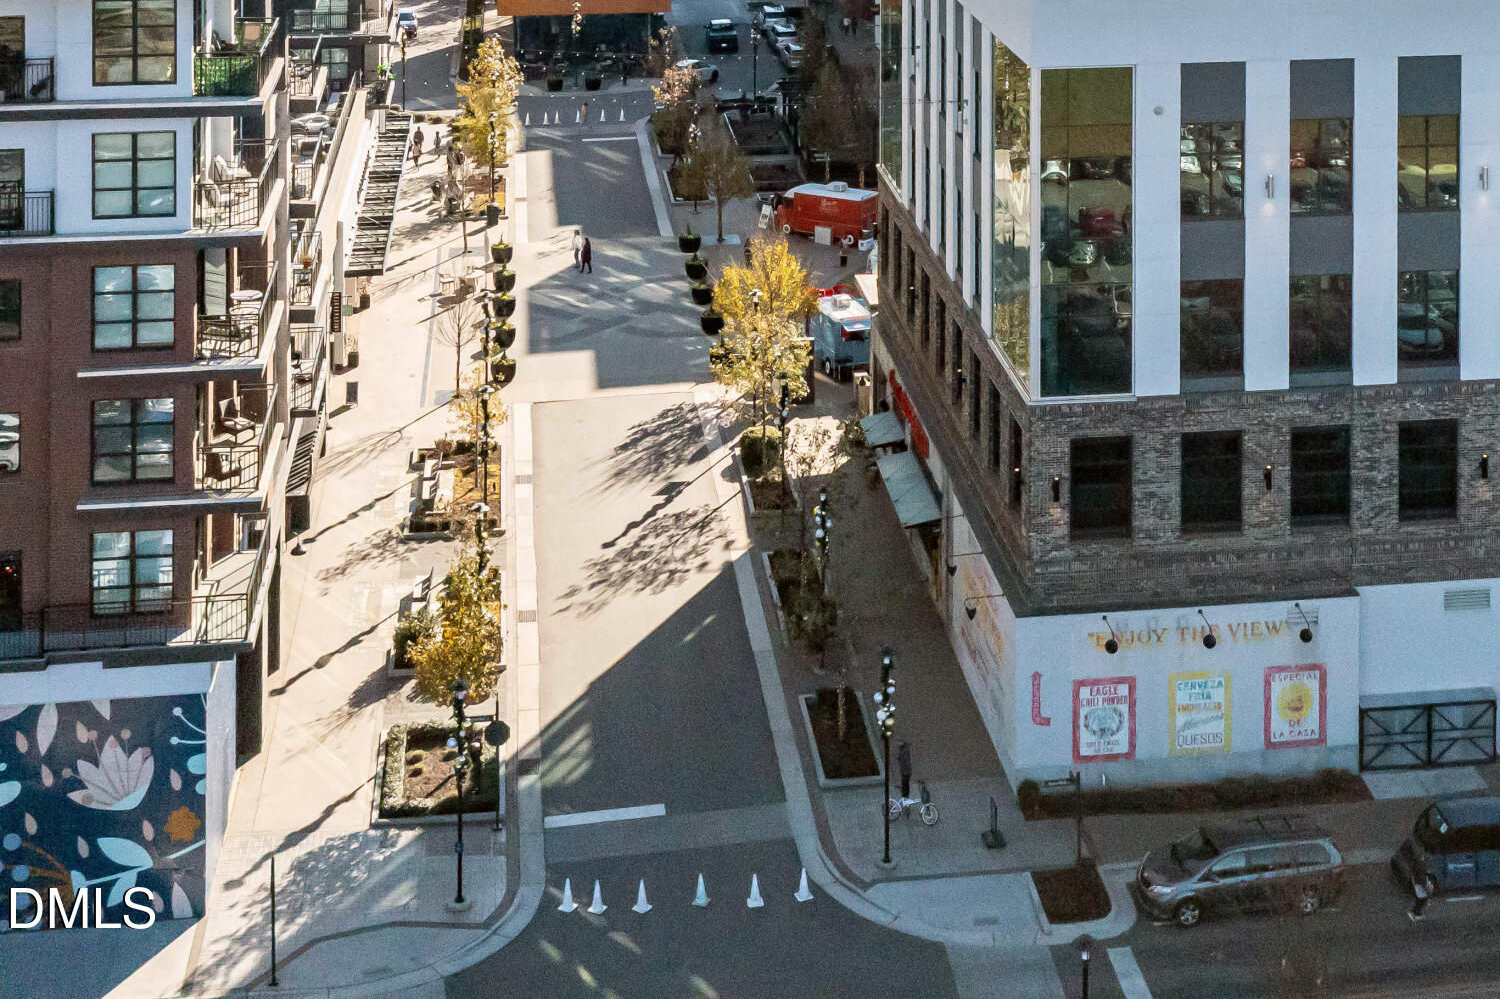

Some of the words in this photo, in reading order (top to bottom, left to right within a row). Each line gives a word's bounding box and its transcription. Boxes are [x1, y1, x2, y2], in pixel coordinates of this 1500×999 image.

[1176, 623, 1221, 646] THE
[1177, 680, 1223, 691] CERVEZA
[1177, 732, 1223, 747] QUESOS
[1272, 730, 1286, 740] LA
